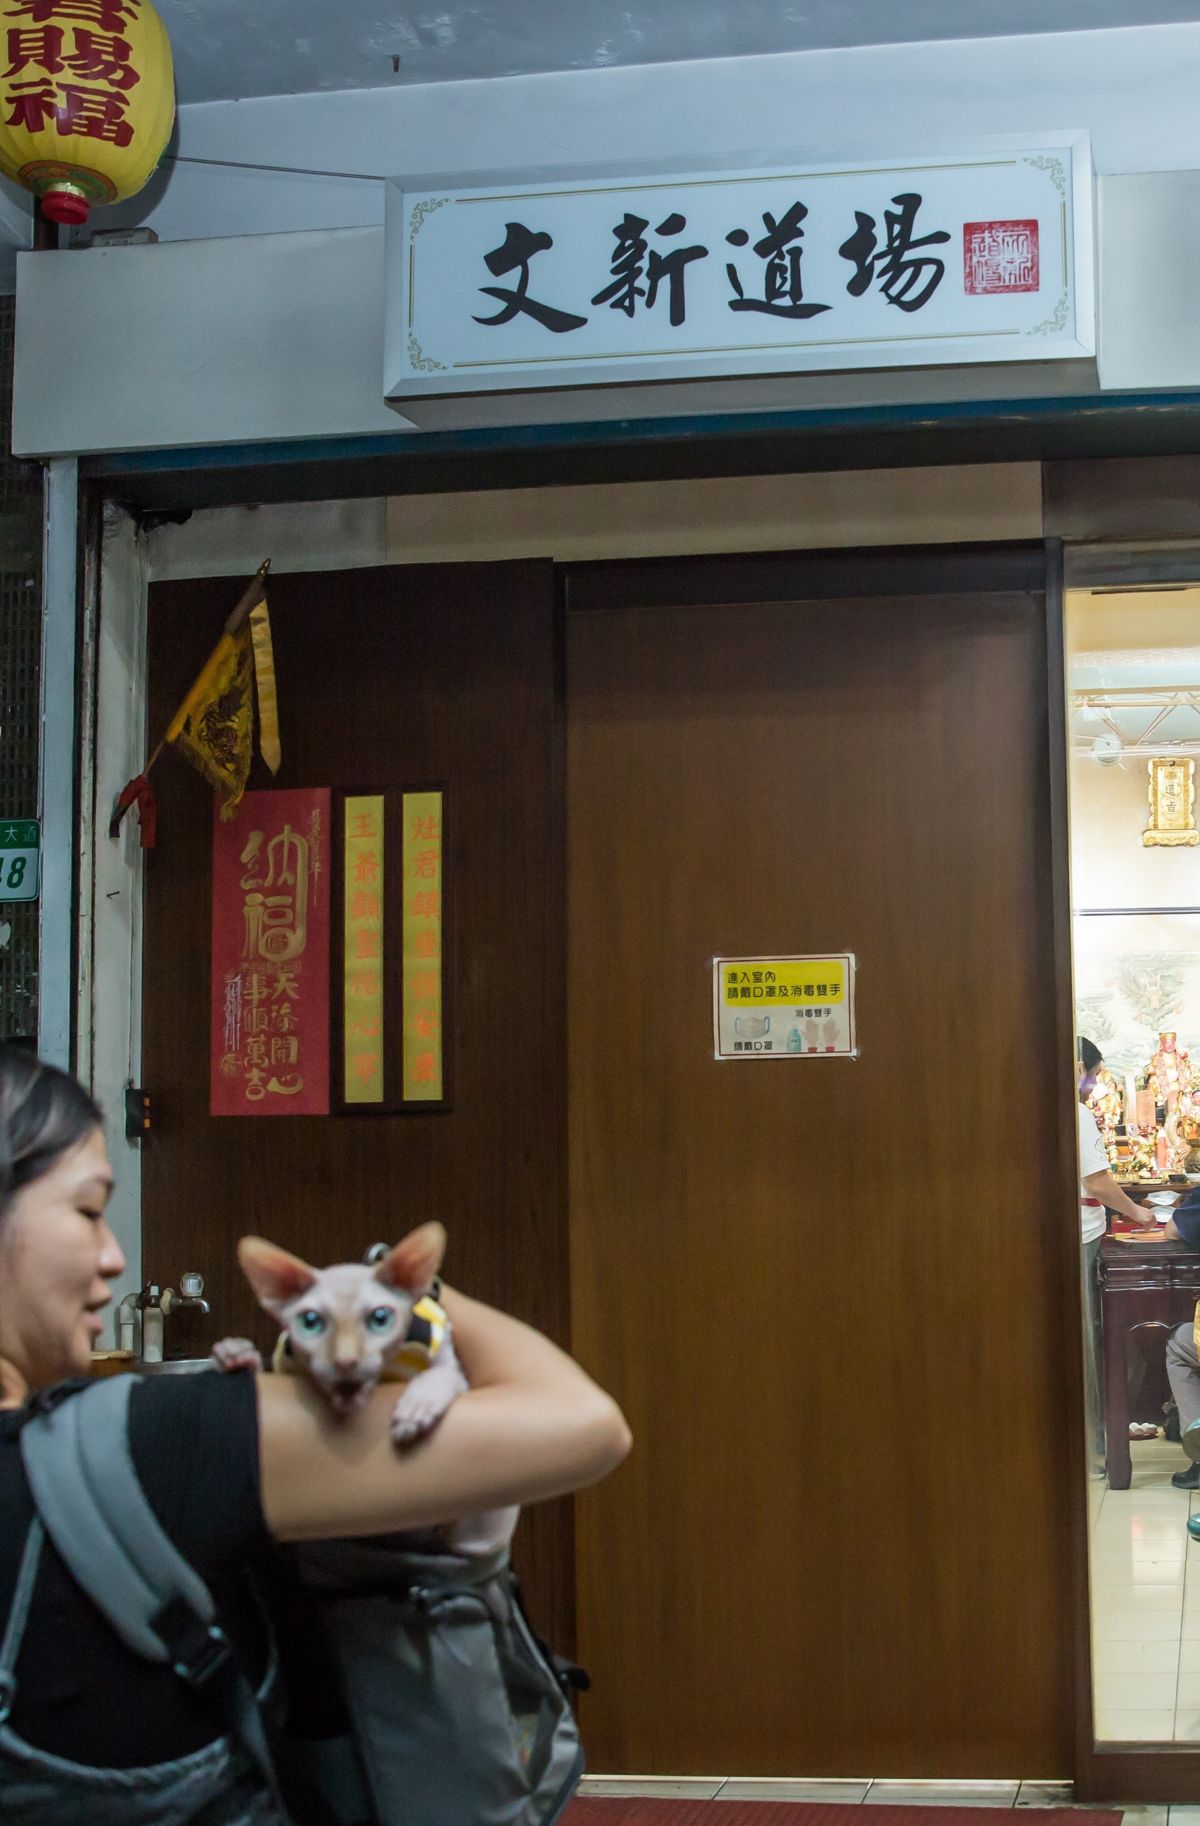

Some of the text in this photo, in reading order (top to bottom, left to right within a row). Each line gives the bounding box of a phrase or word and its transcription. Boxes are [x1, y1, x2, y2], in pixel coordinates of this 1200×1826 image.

[471, 193, 952, 334] 文新道場
[0, 856, 27, 889] 8
[727, 971, 776, 984] 進入室內
[727, 983, 841, 999] 請戴口罩及消毒雙手
[795, 1008, 832, 1018] 消毒雙手
[734, 1041, 773, 1052] 請戴口罩
